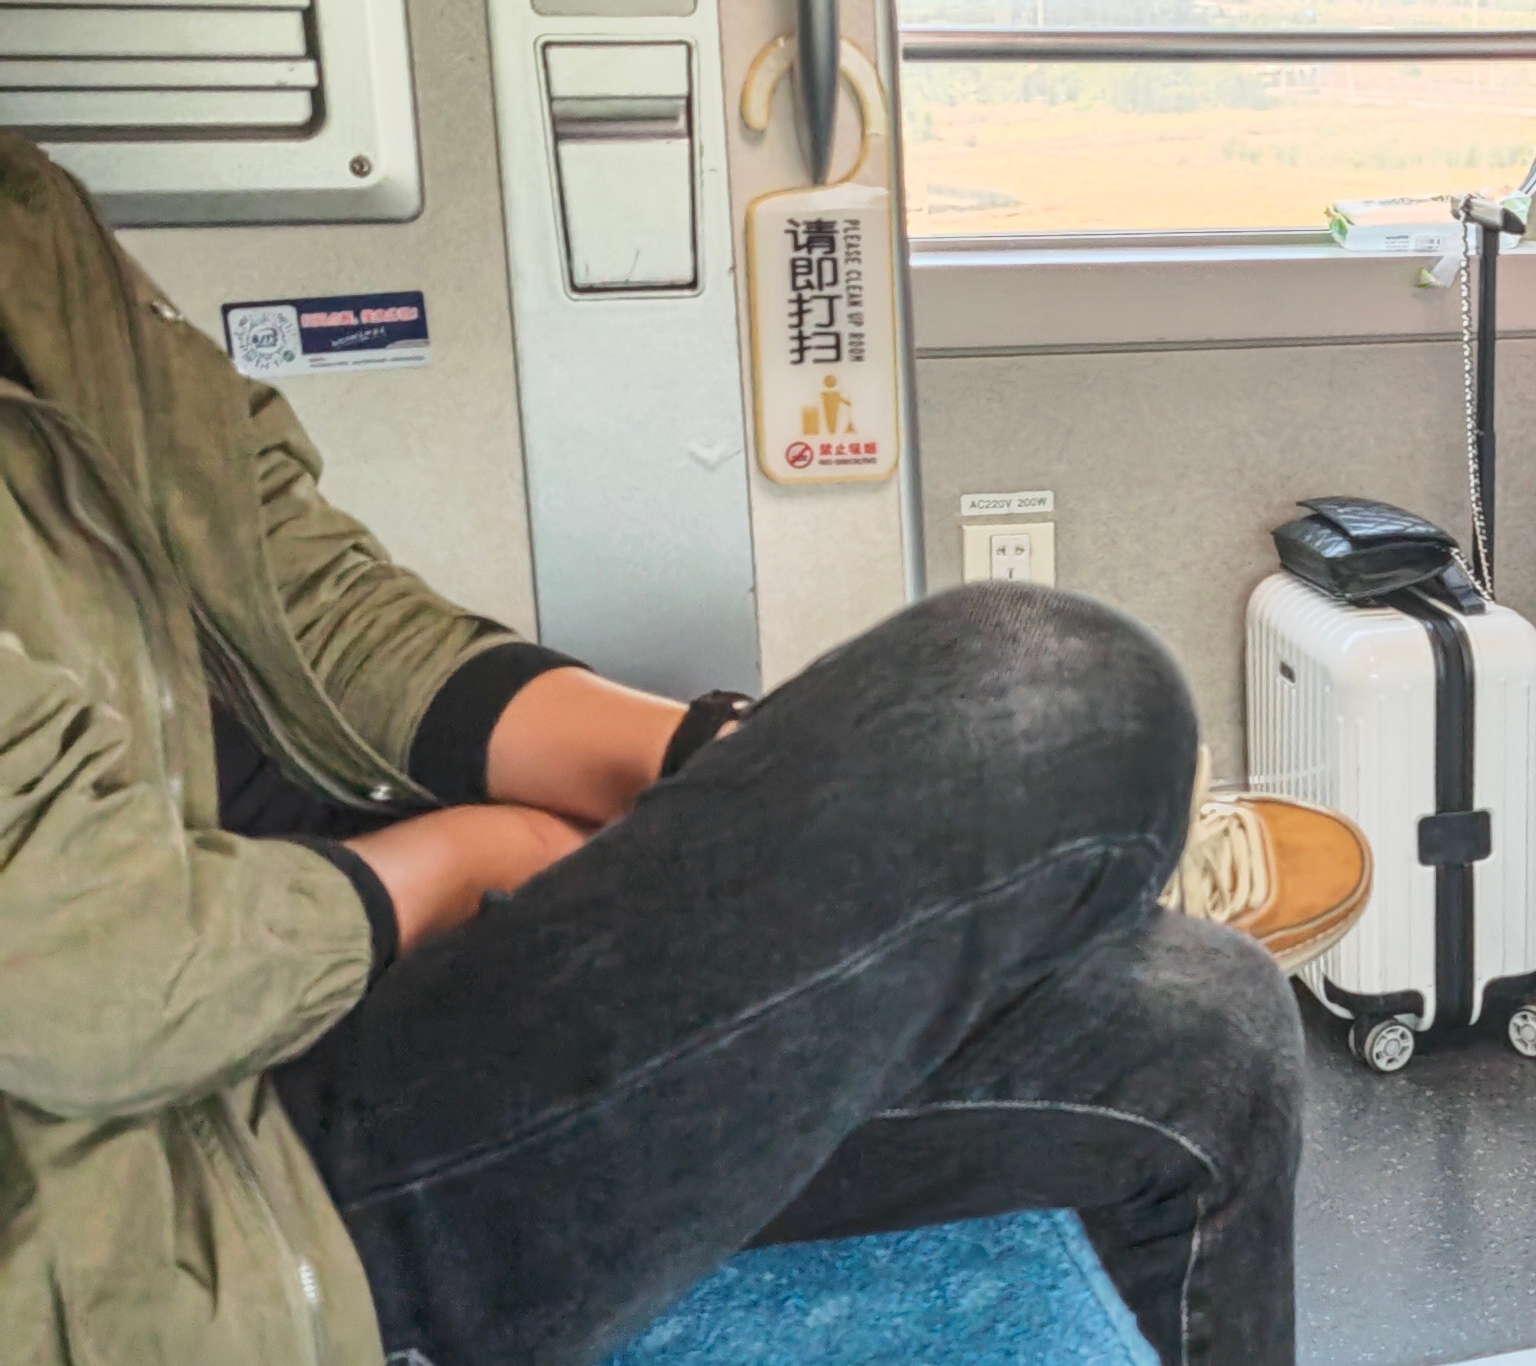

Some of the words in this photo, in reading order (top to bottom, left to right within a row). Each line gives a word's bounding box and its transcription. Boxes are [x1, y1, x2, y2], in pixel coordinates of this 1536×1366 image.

[843, 219, 862, 265] PLEASE
[784, 218, 842, 365] 请即打扫
[845, 269, 864, 307] CLEAN
[847, 311, 864, 327] UP
[848, 332, 866, 362] ROOM
[969, 498, 1013, 510] AC220V
[1017, 496, 1048, 508] 200W
